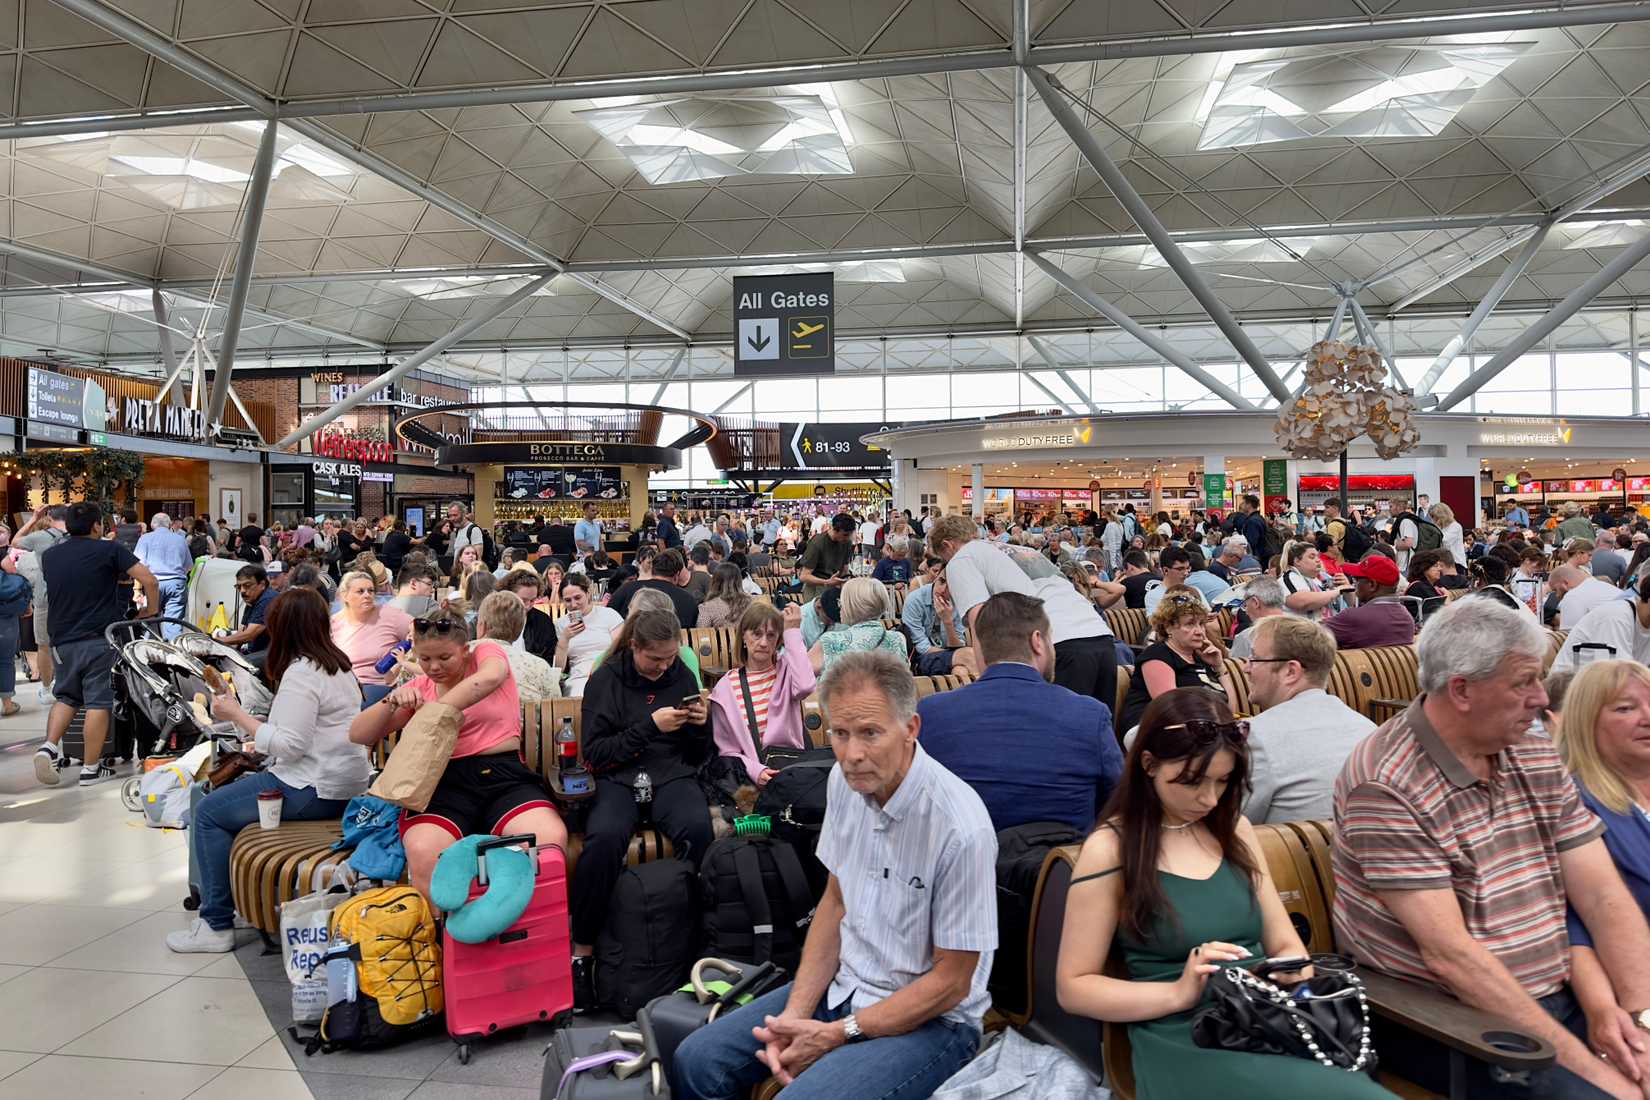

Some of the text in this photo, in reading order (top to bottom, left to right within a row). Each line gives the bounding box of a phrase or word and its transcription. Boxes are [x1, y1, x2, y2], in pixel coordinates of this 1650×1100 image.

[739, 291, 829, 309] All Gates
[39, 374, 69, 391] All gates
[311, 373, 343, 382] WINES
[38, 390, 57, 403] Toilets
[401, 387, 416, 404] bar
[38, 406, 59, 420] Escape
[60, 411, 79, 424] lounge
[125, 397, 153, 432] PRET
[165, 405, 207, 438] MANGER
[530, 445, 605, 455] BOTTEGA
[815, 441, 850, 453] 81-93
[312, 461, 338, 475] CASK
[339, 463, 361, 477] ALES
